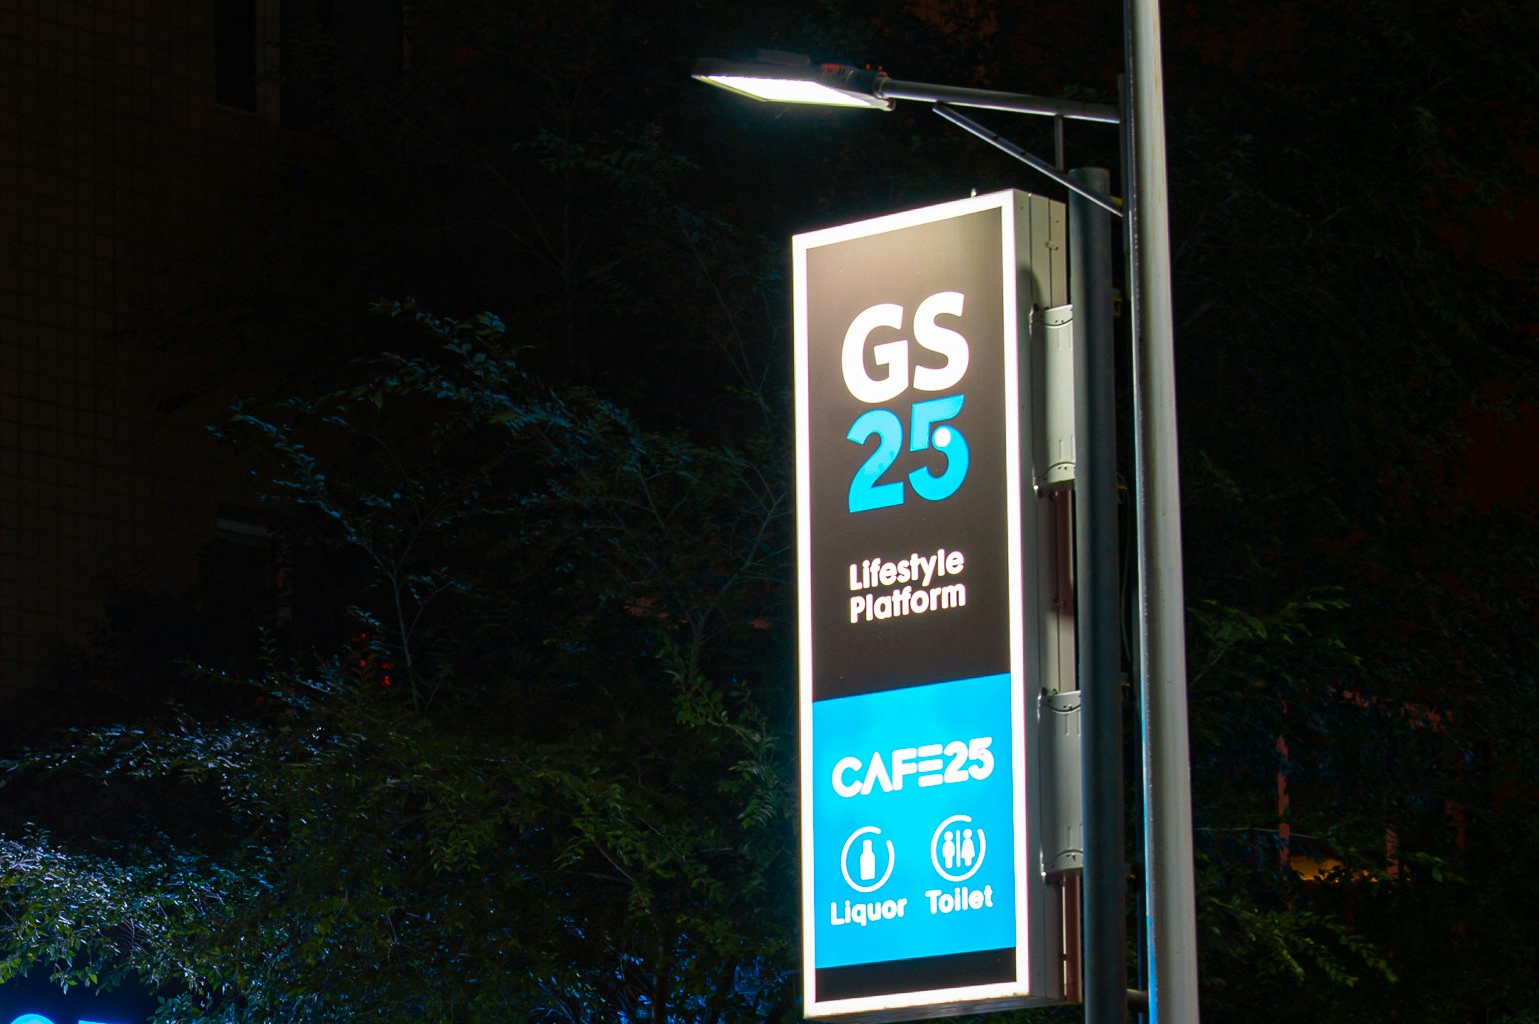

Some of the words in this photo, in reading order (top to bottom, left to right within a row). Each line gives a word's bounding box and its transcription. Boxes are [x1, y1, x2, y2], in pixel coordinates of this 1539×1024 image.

[842, 291, 970, 403] GS
[846, 394, 970, 513] 25
[849, 549, 965, 591] Lifestyle
[850, 581, 966, 623] Platform
[831, 736, 995, 798] CAFE25
[830, 897, 908, 926] Liquor
[925, 884, 993, 915] Toilet
